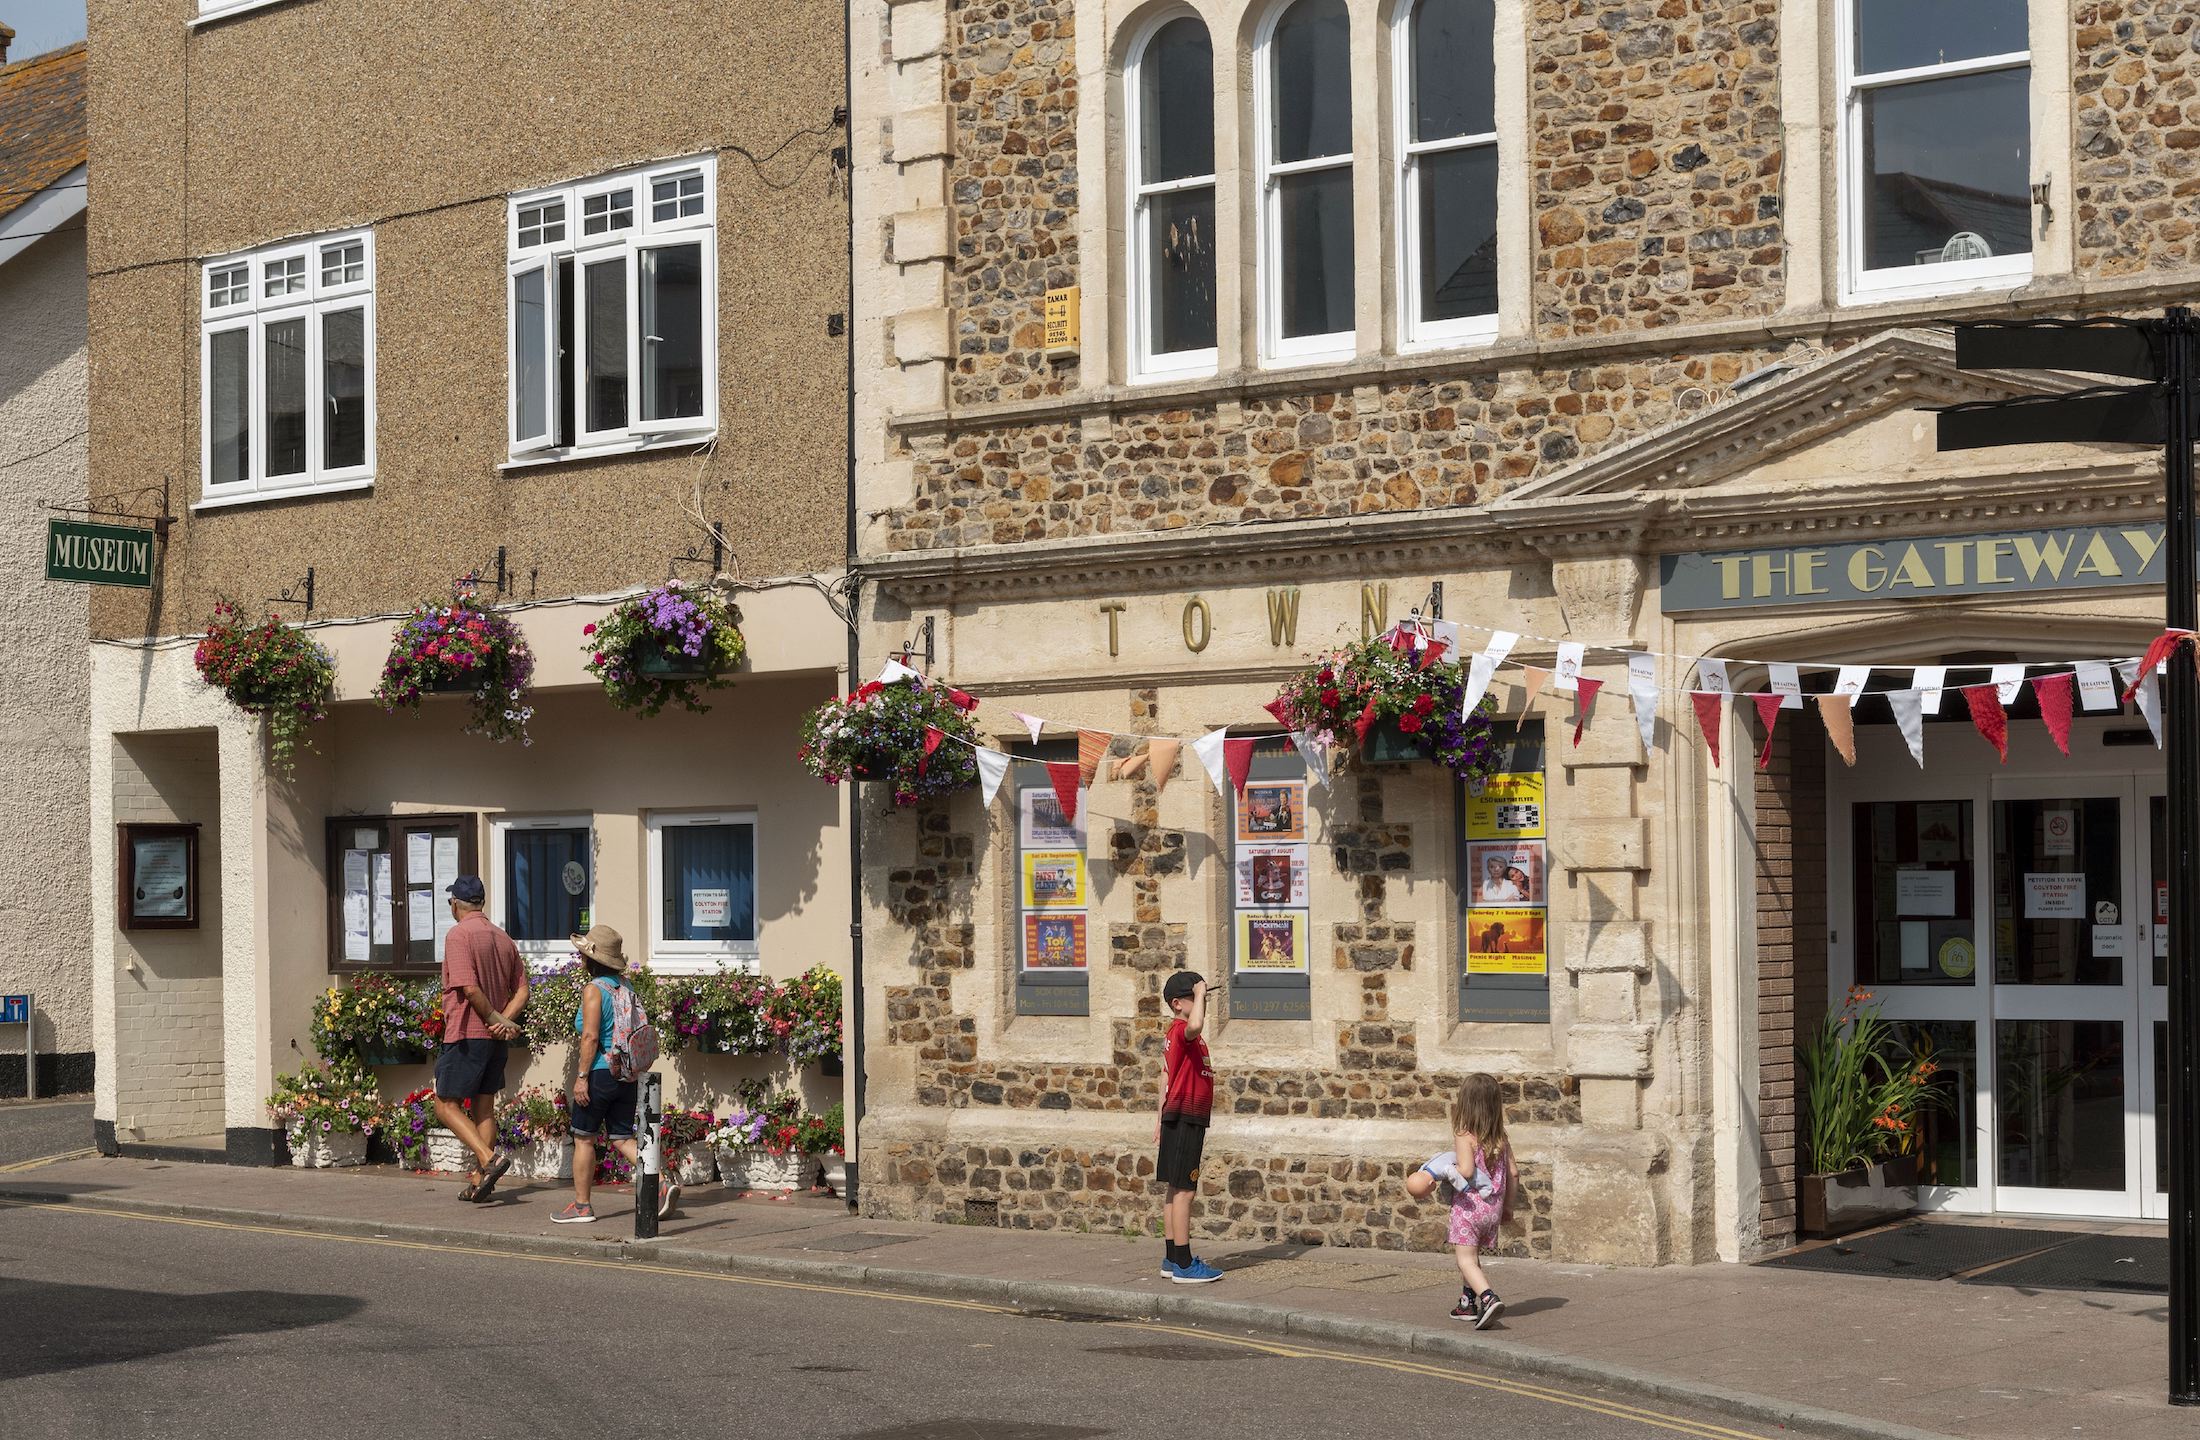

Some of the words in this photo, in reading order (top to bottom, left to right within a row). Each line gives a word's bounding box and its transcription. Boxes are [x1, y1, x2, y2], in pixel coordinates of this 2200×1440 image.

[1047, 294, 1068, 303] TAMAR
[1047, 320, 1068, 329] SECURITY
[53, 533, 149, 575] MUSEUM
[1712, 550, 1830, 599] THE
[1847, 528, 2166, 592] GATEWAY
[1100, 582, 1388, 657] TOWN
[1035, 871, 1057, 880] PATSY
[1045, 936, 1067, 946] TOY
[1052, 951, 1061, 960] 4
